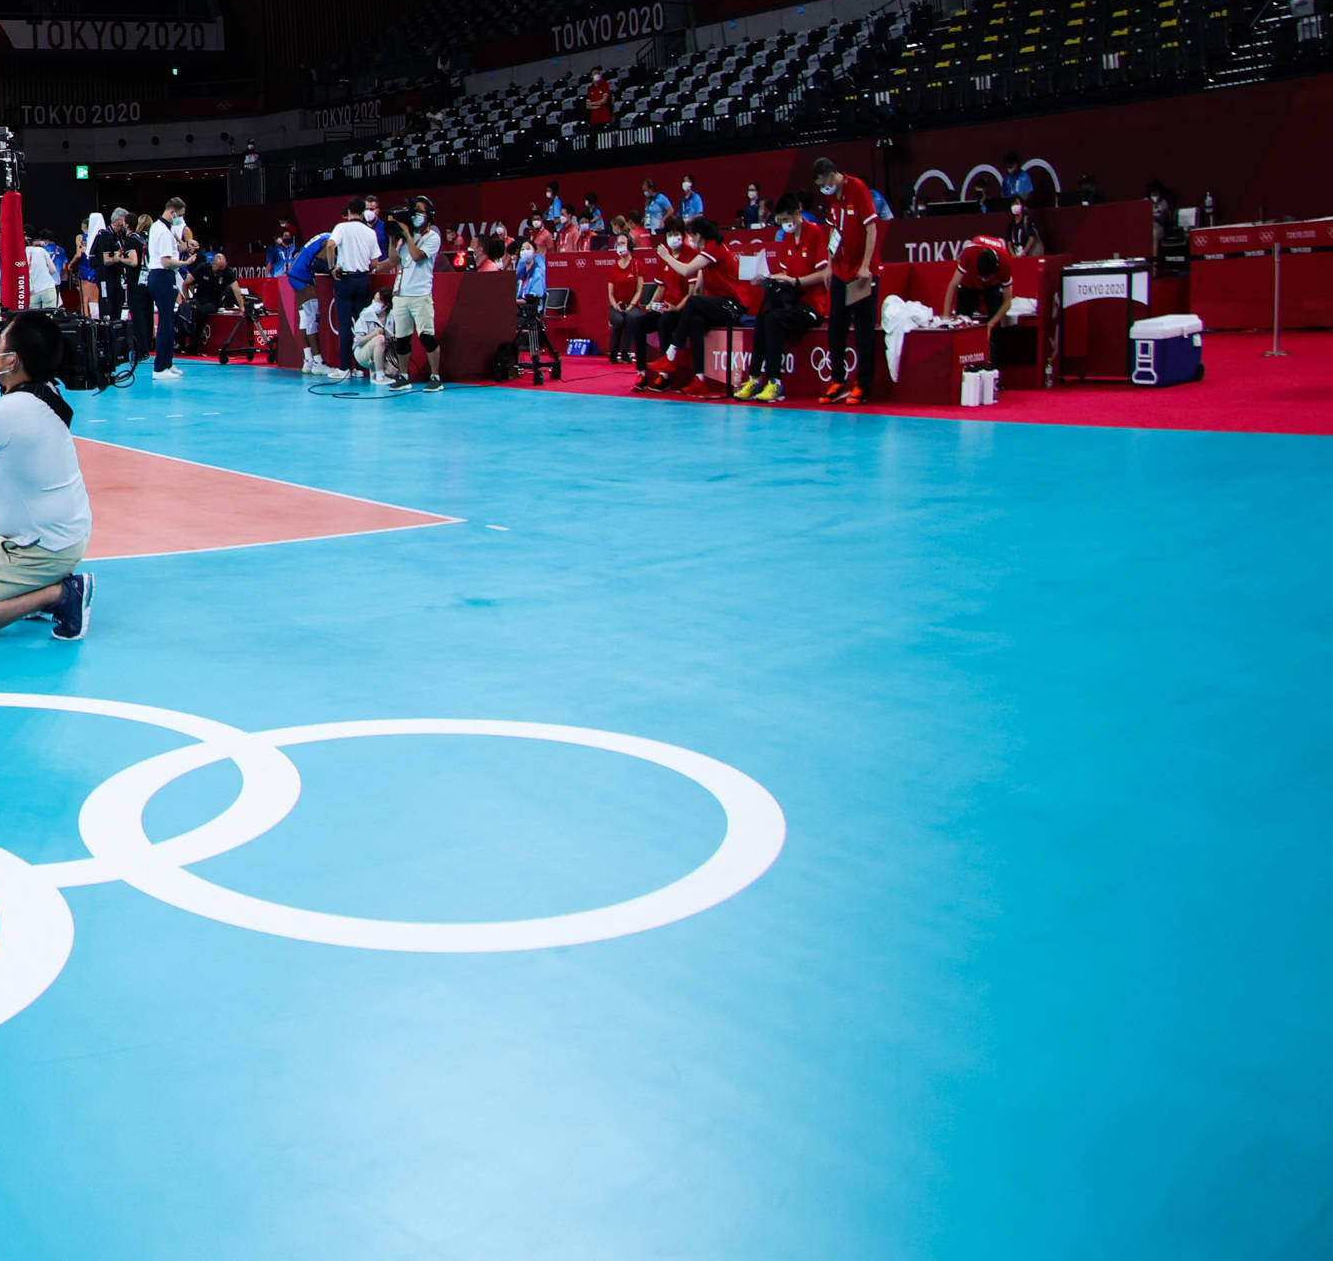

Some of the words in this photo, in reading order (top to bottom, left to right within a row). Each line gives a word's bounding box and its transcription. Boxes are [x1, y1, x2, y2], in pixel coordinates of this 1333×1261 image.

[27, 19, 127, 51] TOKYO
[136, 22, 206, 51] 2020
[551, 13, 613, 53] TOKYO
[616, 2, 665, 40] 2020
[20, 104, 87, 125] TOKYO
[92, 101, 142, 125] 2020
[316, 104, 352, 130] TOKYO
[353, 99, 382, 121] 2020
[233, 266, 254, 279] OKYO
[1077, 284, 1104, 296] TOKYO
[1104, 283, 1125, 294] 2020
